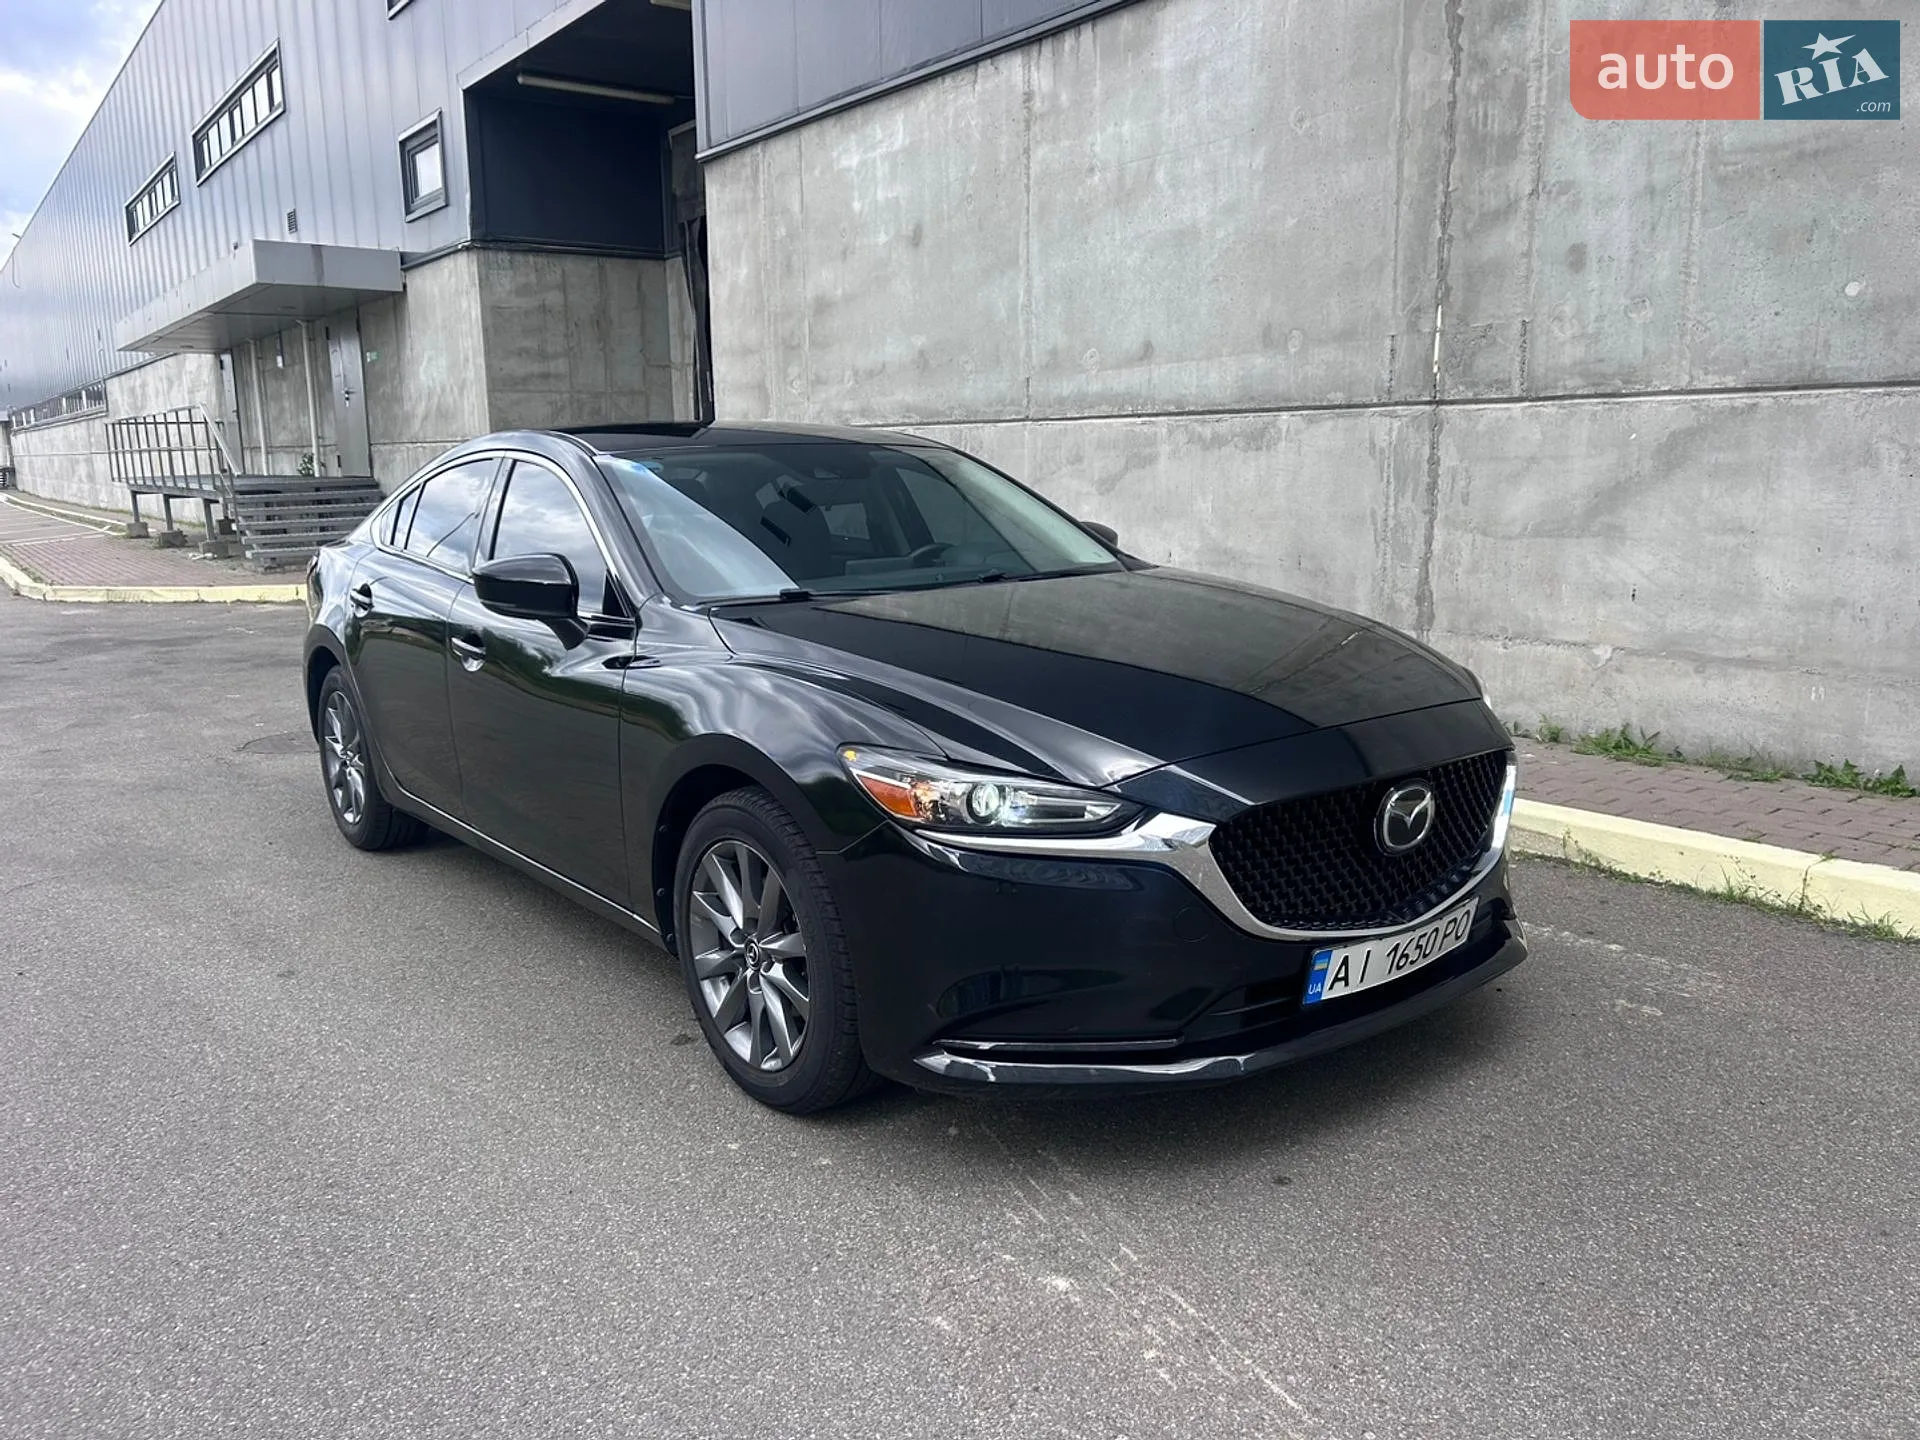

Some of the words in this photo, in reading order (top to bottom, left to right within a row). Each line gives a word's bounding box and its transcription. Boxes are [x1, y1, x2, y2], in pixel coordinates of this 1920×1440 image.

[1328, 950, 1371, 991] AI
[1387, 926, 1439, 975] 1650
[1438, 909, 1470, 951] PO
[1308, 983, 1321, 995] UA
